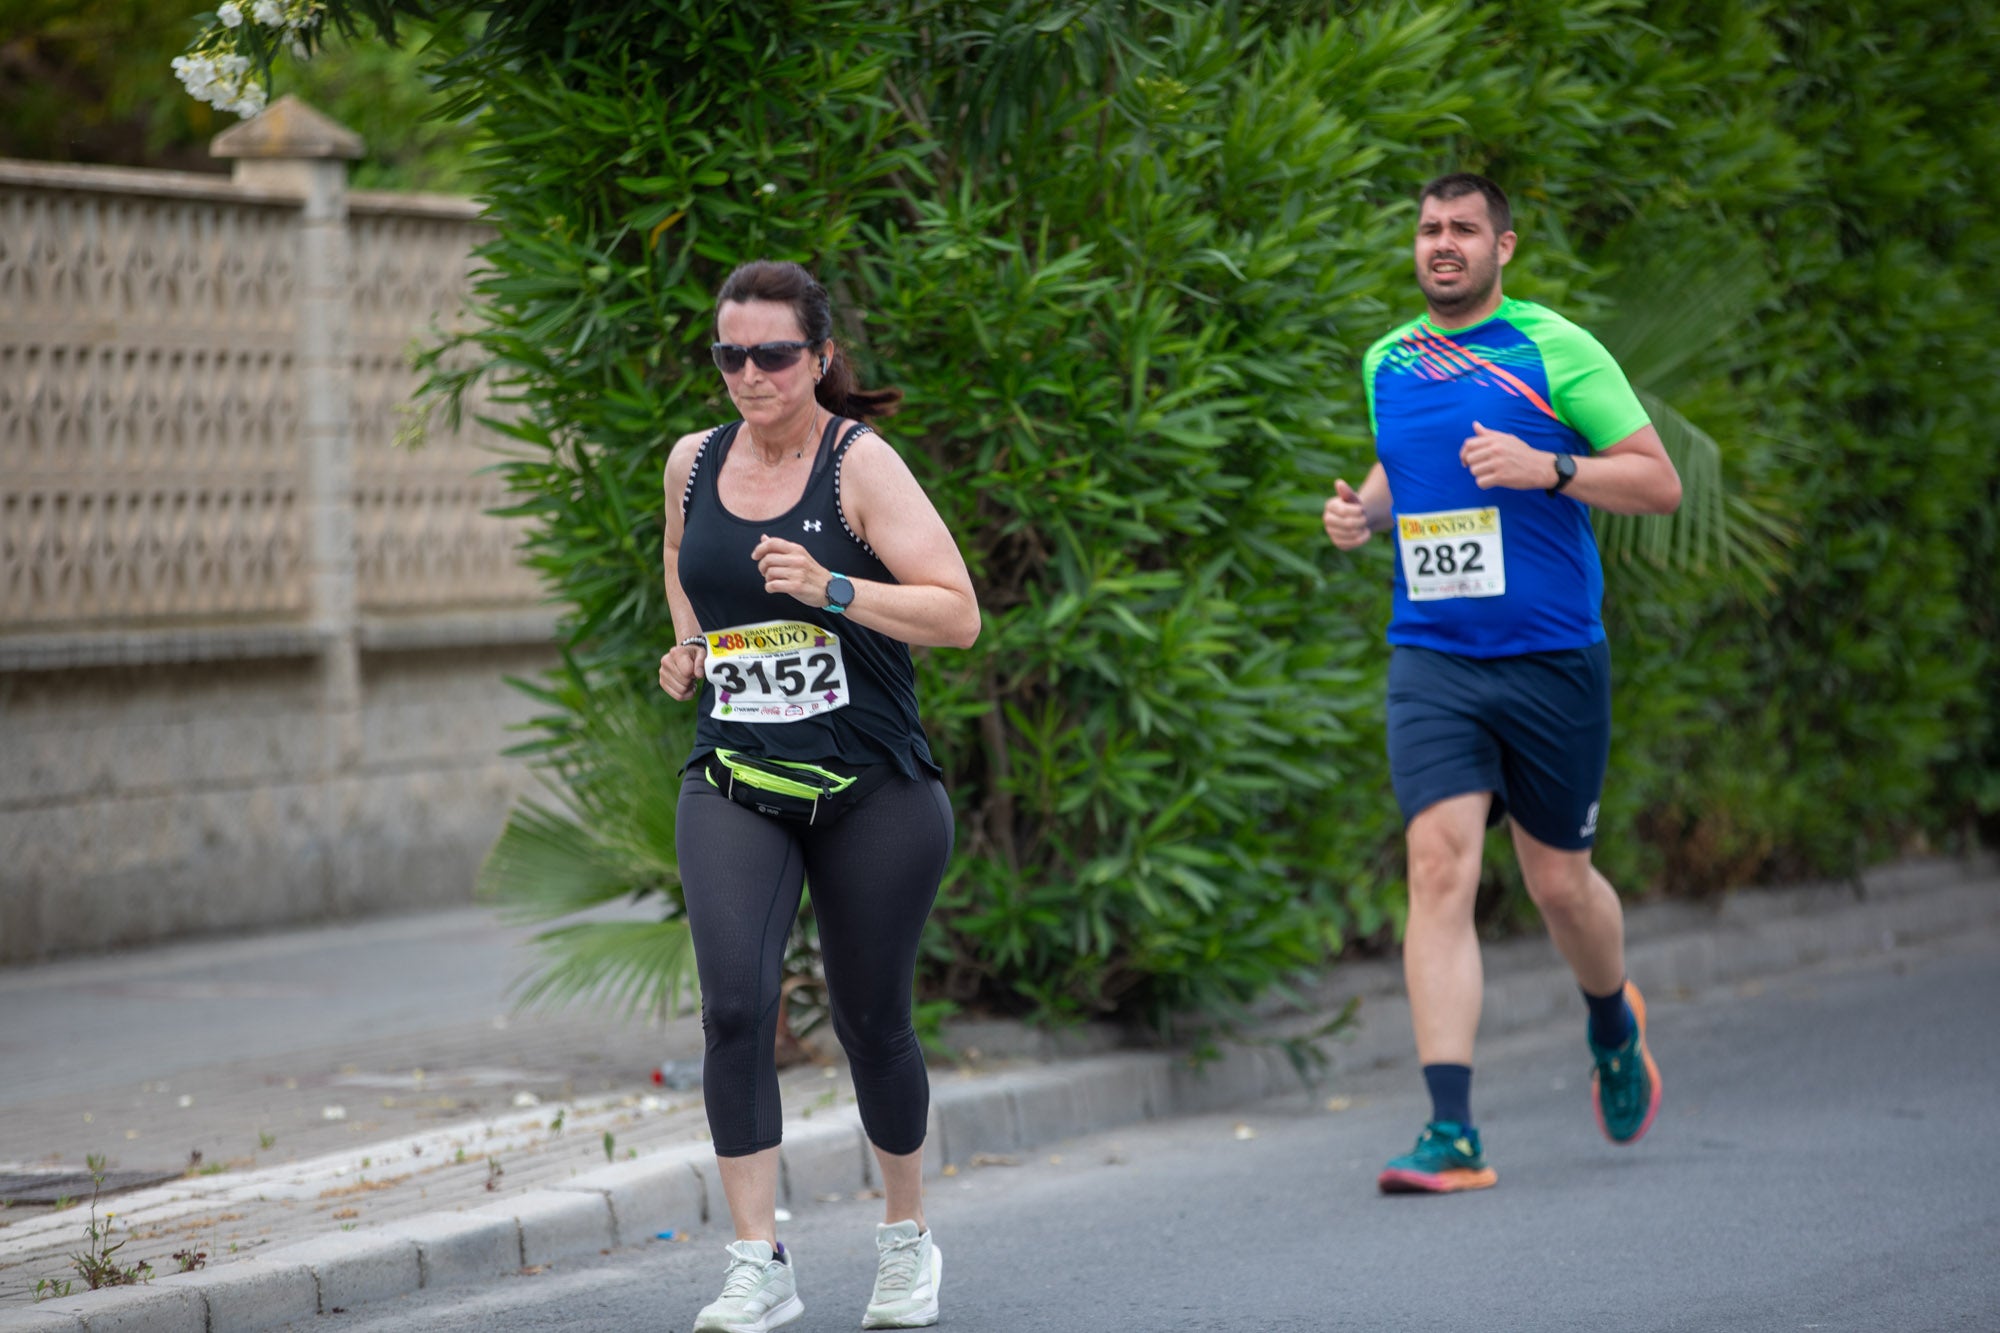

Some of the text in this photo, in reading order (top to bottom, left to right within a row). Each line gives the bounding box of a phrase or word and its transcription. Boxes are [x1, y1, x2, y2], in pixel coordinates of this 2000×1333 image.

[1414, 542, 1484, 576] 282
[726, 630, 807, 651] 38 FONDO
[767, 624, 801, 635] PREMIO
[712, 653, 841, 697] 3152
